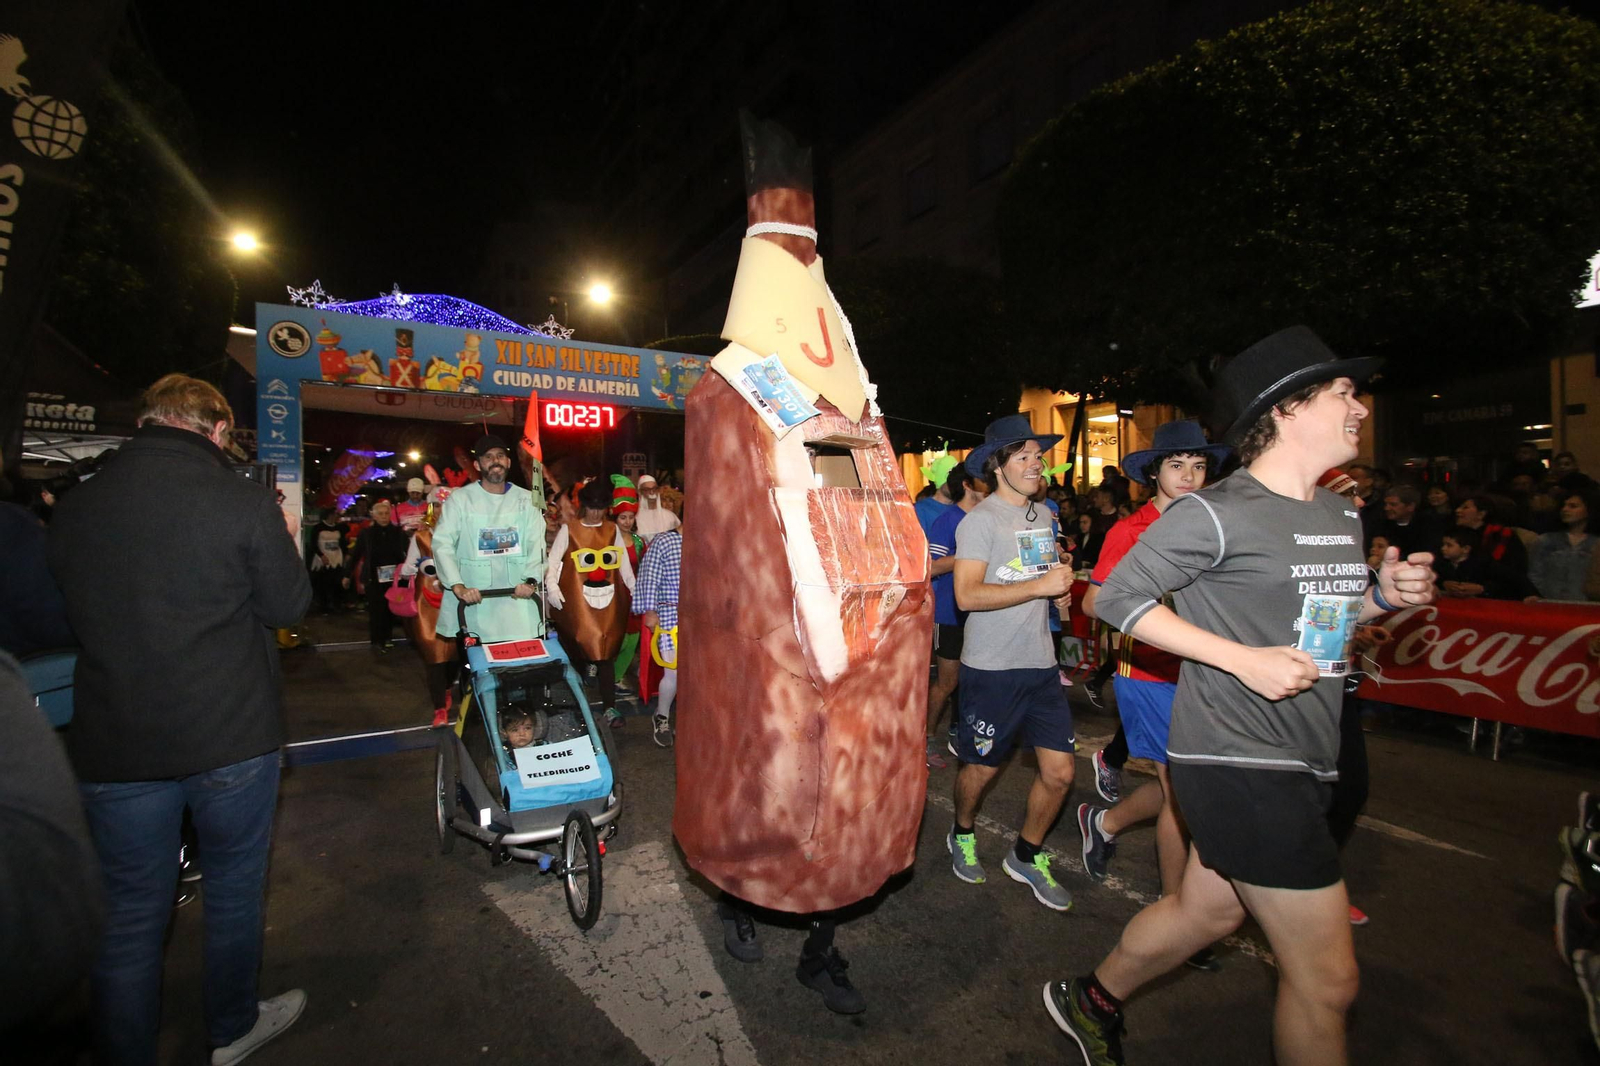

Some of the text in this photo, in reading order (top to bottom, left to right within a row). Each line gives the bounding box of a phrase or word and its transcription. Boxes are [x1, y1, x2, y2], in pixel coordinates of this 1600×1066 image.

[799, 307, 835, 368] J
[494, 338, 640, 378] XII SAN SILVESTRE
[492, 370, 640, 397] CIUDAD DE ALMERÍA
[434, 395, 496, 411] CIUDAD
[771, 386, 805, 419] 1301
[1293, 533, 1356, 546] BRIDGESTONE
[1290, 564, 1327, 577] XXXIX
[1298, 581, 1317, 594] DE
[1318, 580, 1332, 593] LA
[536, 749, 574, 761] COCHE
[527, 764, 591, 779] TELEDIRIGIDO
